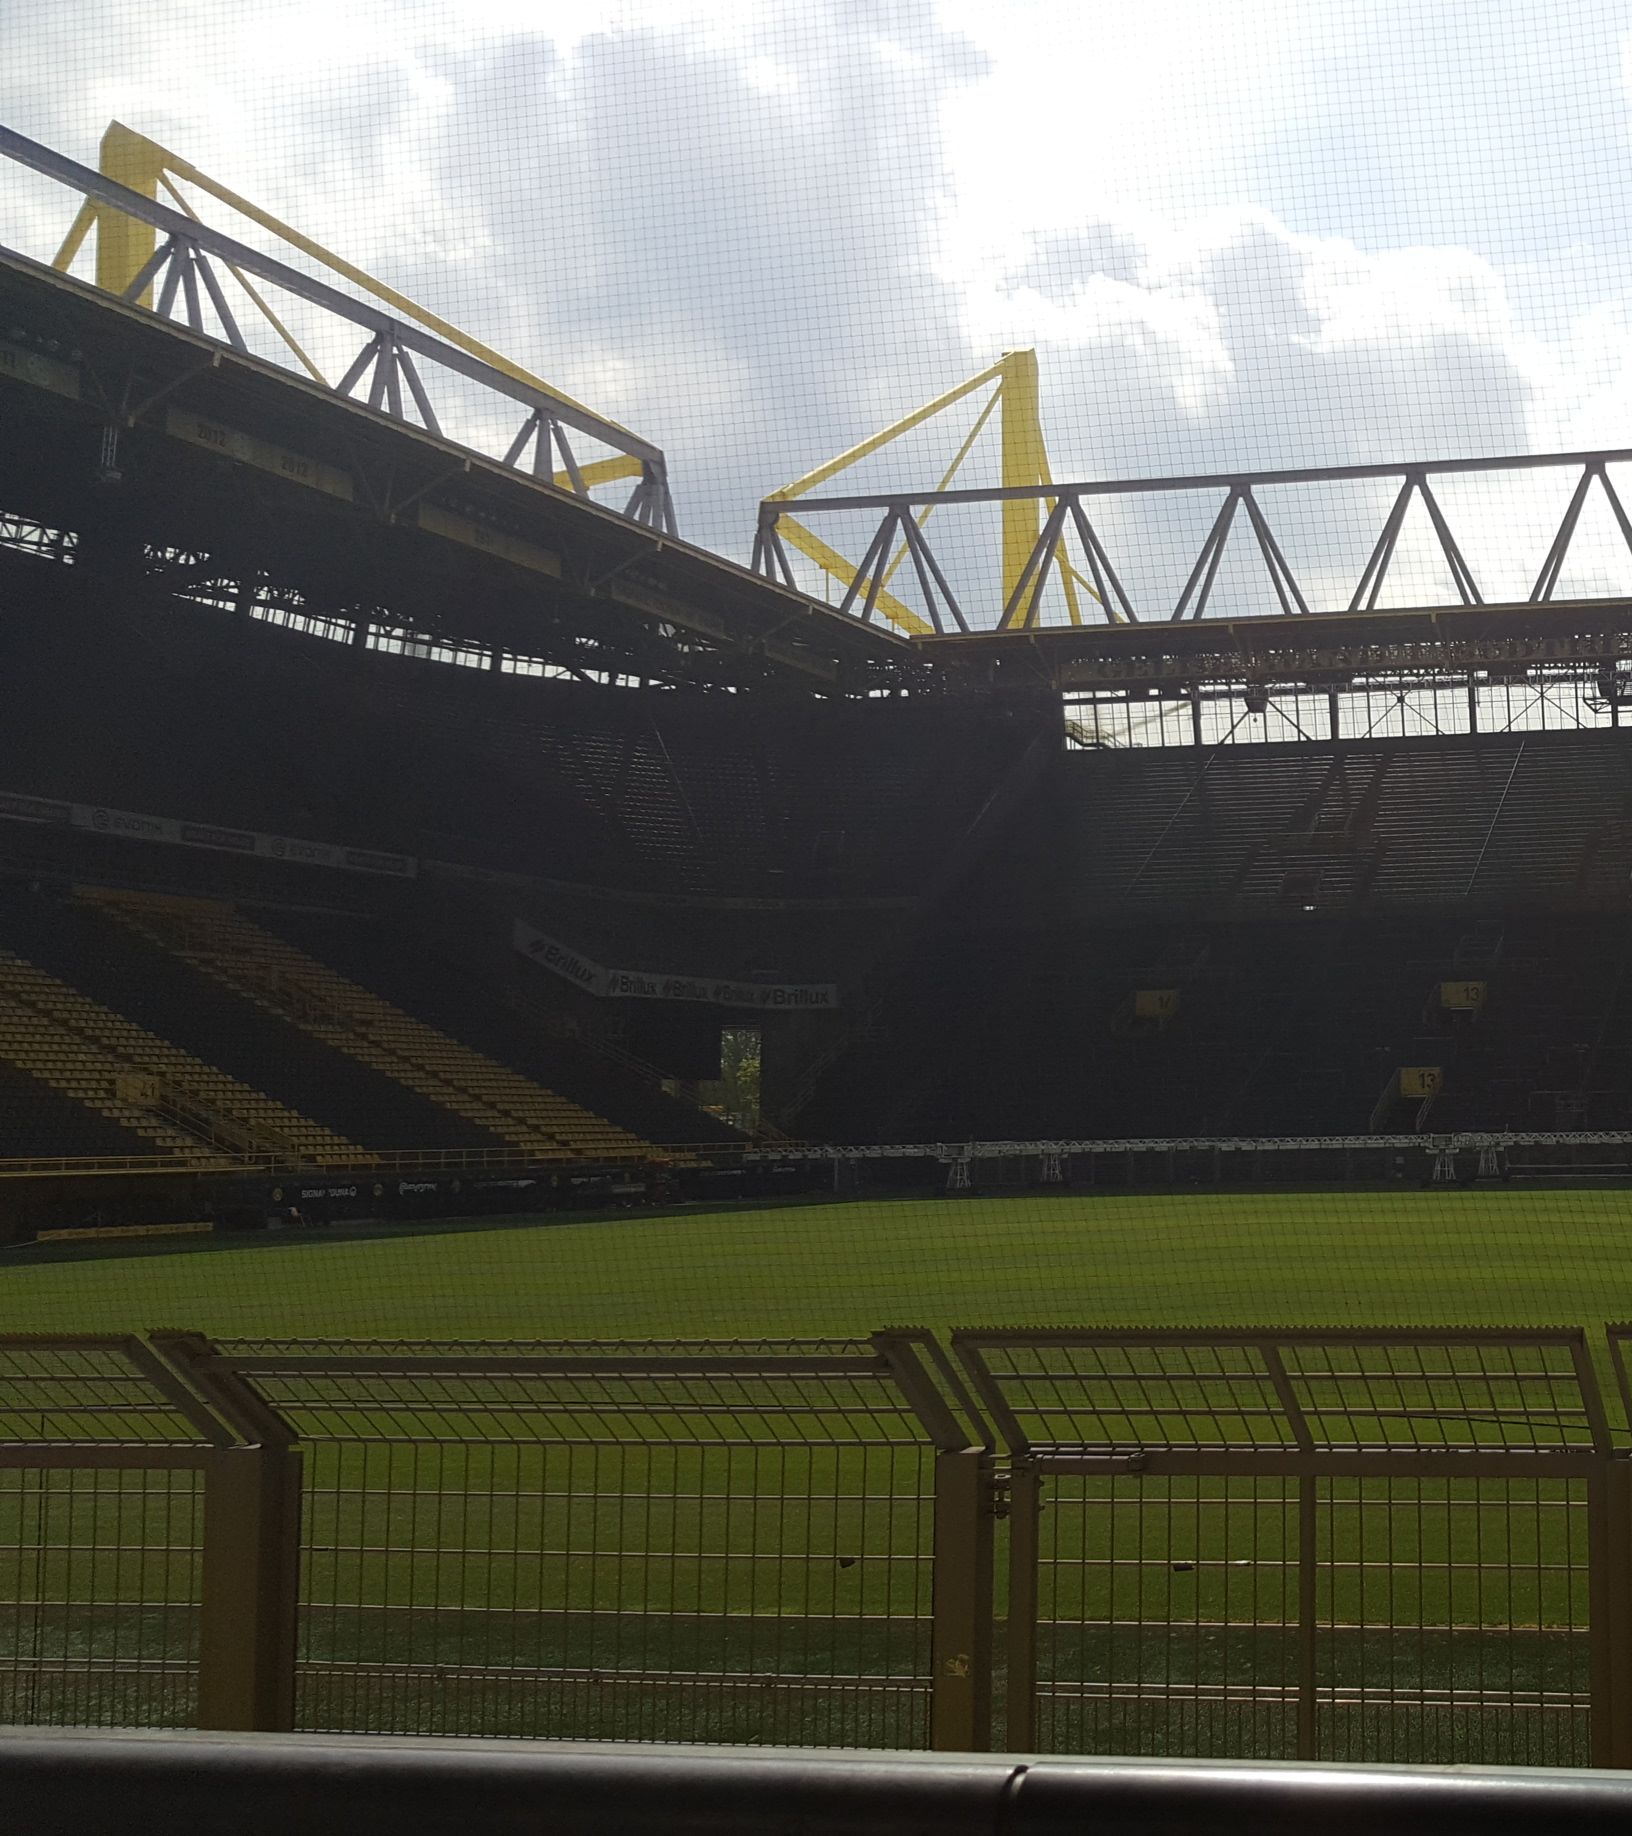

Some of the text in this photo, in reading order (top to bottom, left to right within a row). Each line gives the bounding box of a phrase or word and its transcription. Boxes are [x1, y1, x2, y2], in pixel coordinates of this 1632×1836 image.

[544, 945, 597, 982] Brillux
[619, 975, 658, 995] Brillux
[773, 988, 830, 1005] Brillux
[1463, 986, 1480, 1003] 13
[1418, 1072, 1436, 1090] 13
